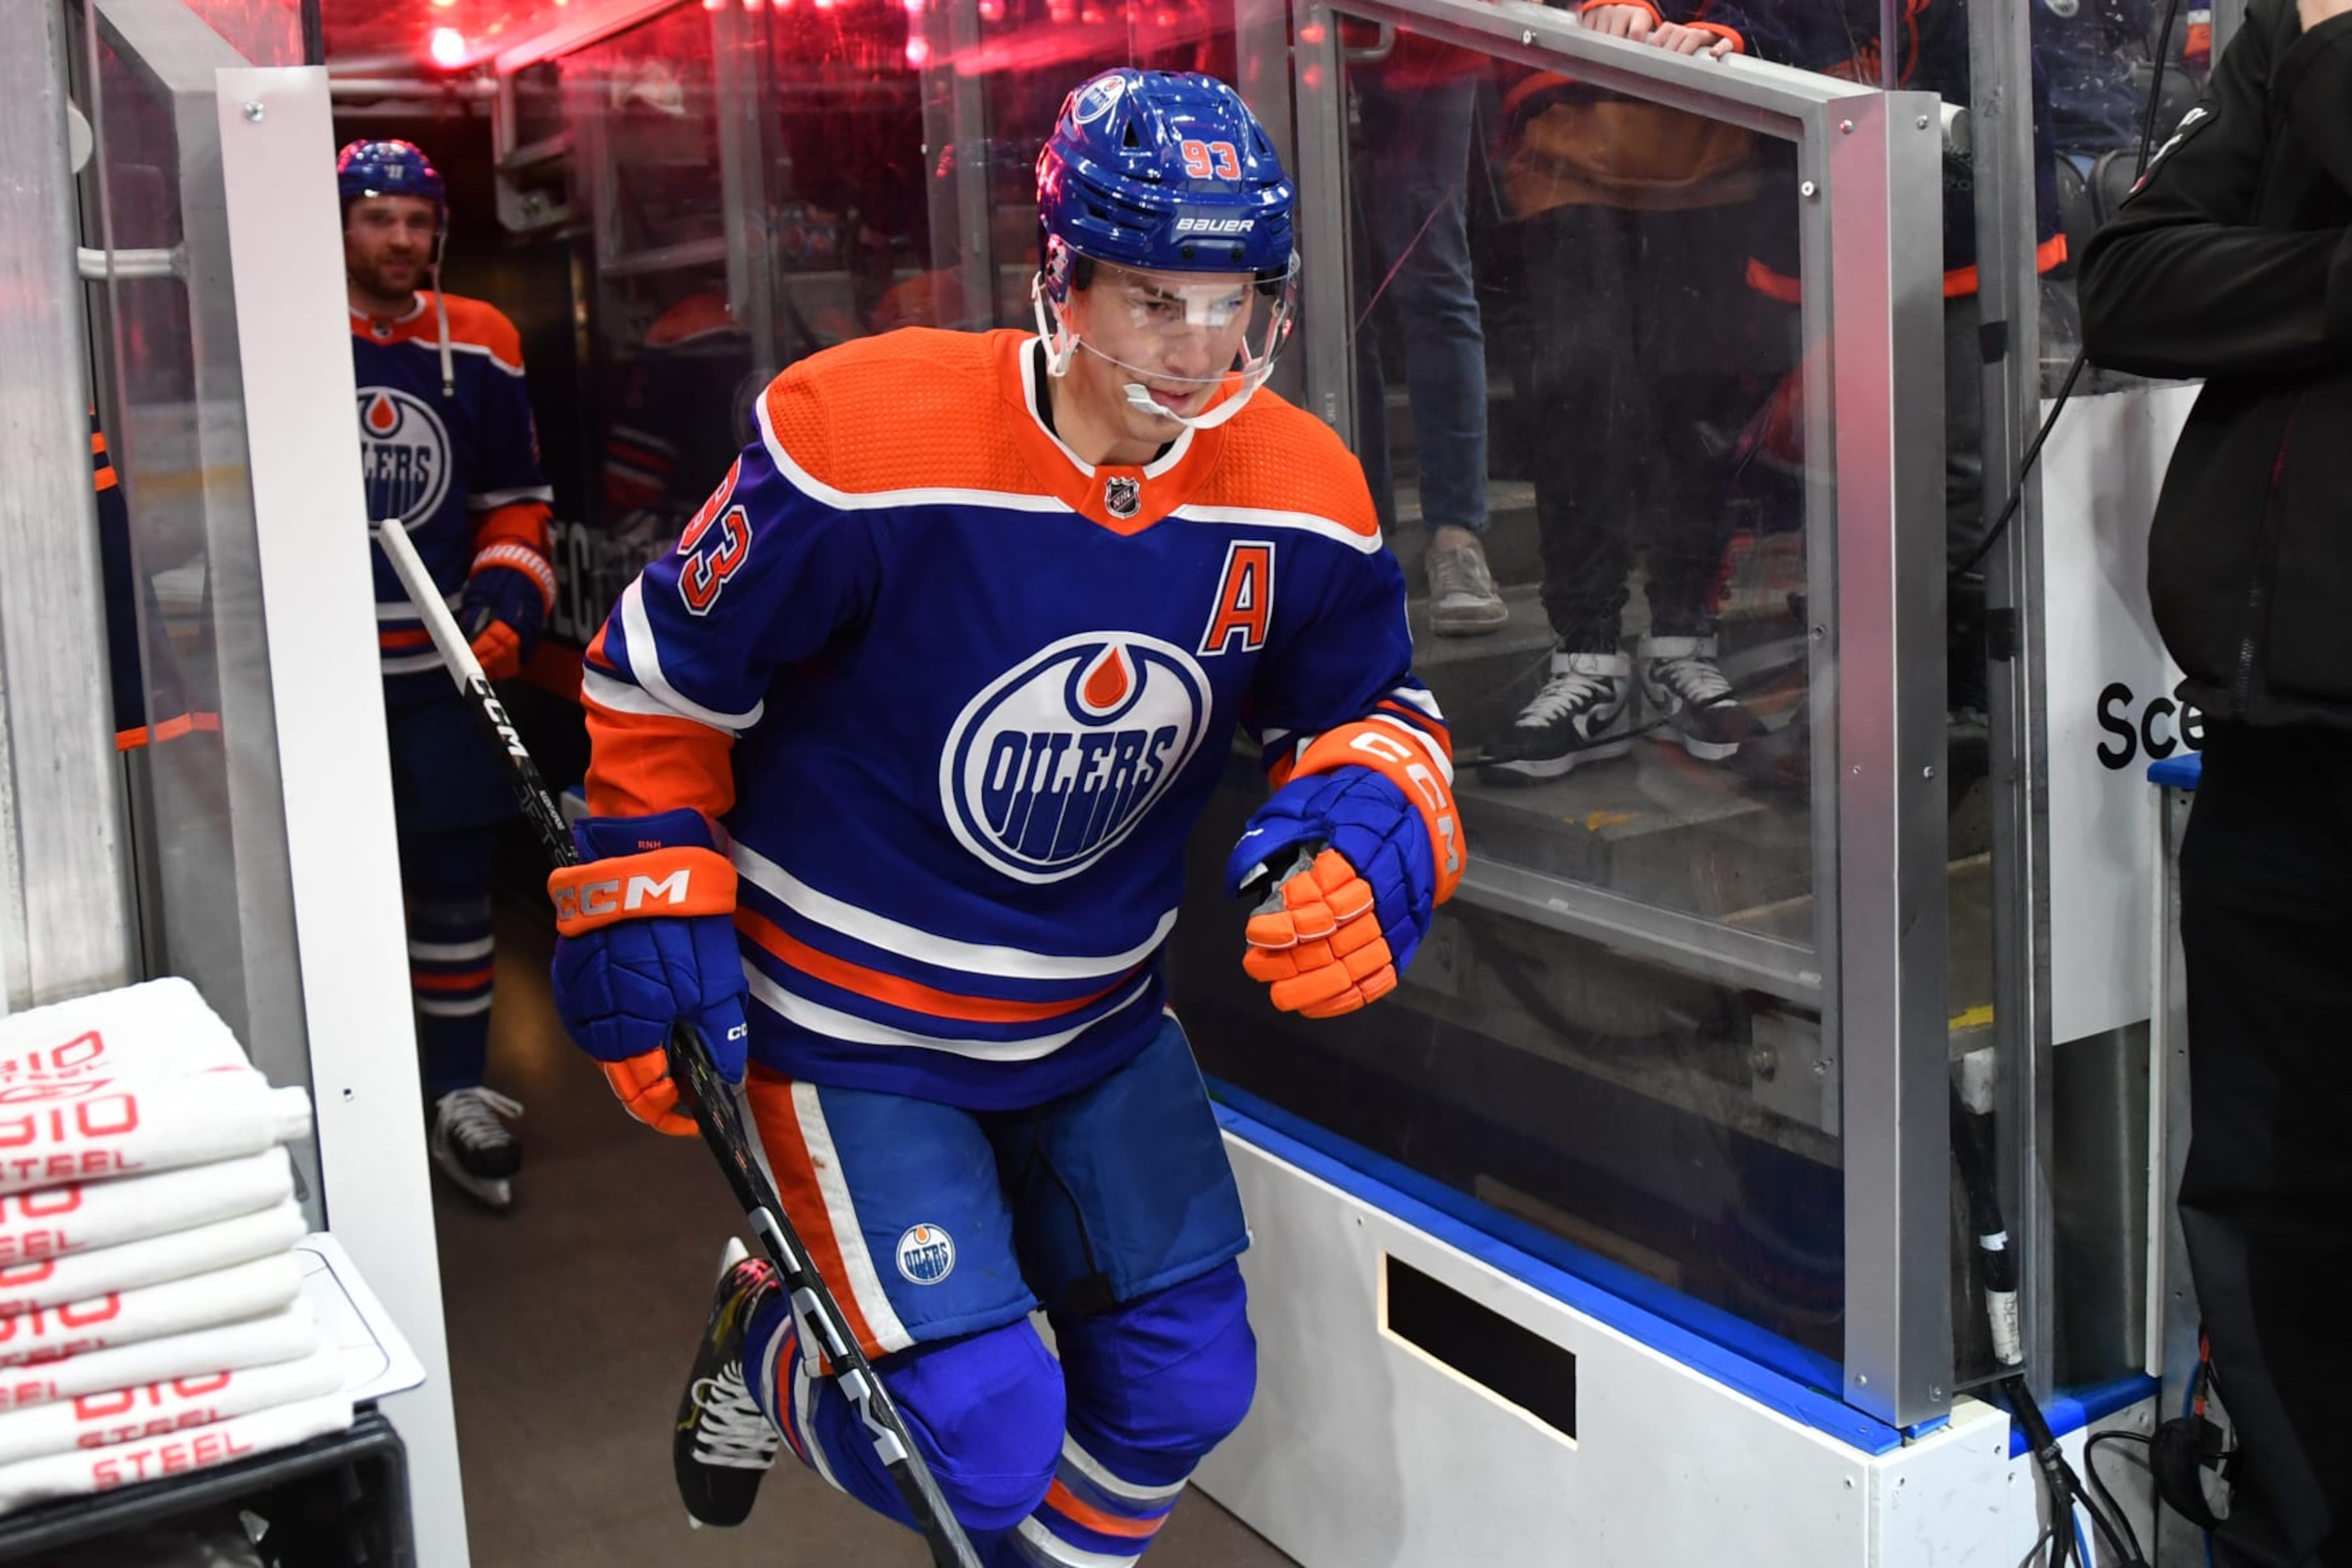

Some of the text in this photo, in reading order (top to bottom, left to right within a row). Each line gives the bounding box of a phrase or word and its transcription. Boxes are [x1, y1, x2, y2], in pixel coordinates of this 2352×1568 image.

[1181, 138, 1242, 181] 93
[1197, 540, 1276, 657] A
[469, 674, 530, 758] CCM
[981, 725, 1178, 851] OILERS
[1349, 732, 1460, 874] CCM
[638, 840, 662, 850] RNH
[554, 869, 692, 921] CCM
[904, 1242, 949, 1278] OILERS
[93, 1432, 253, 1491] STEEL
